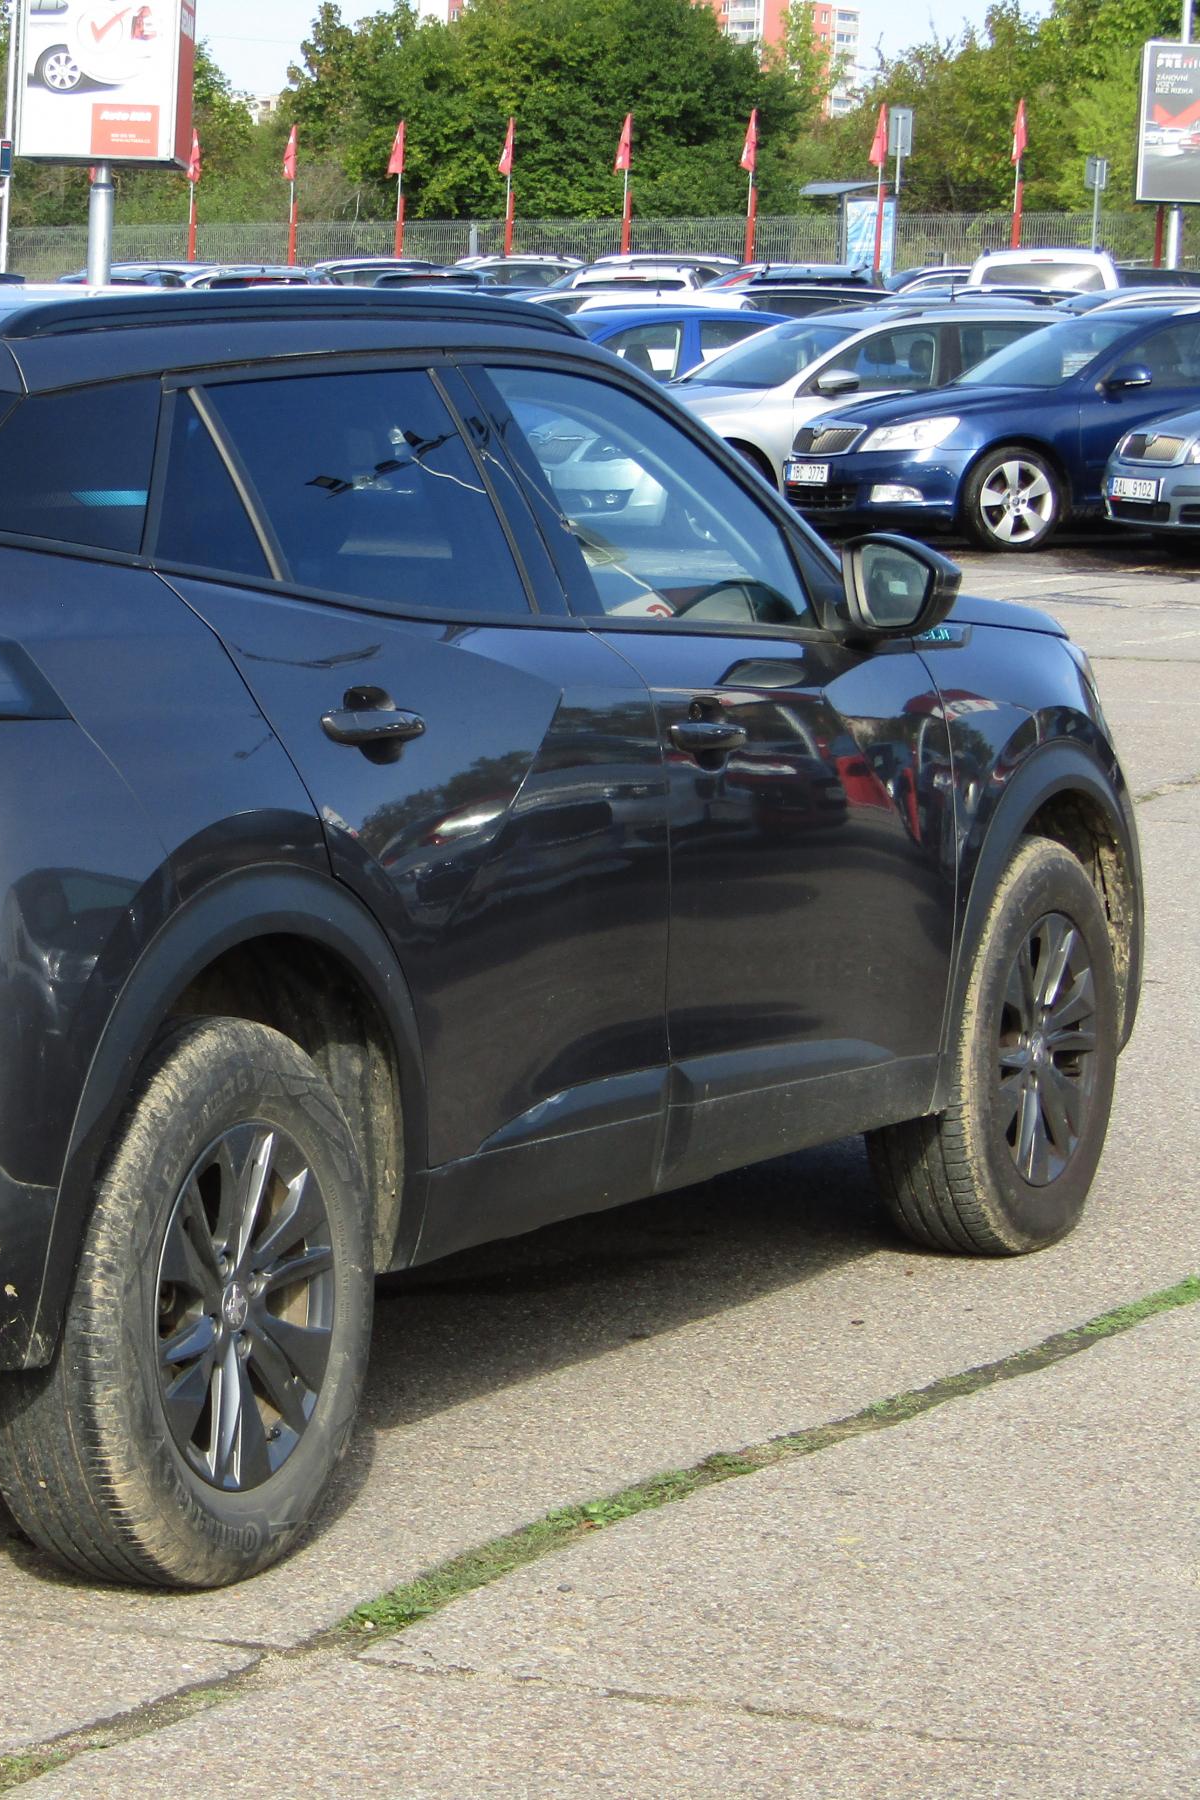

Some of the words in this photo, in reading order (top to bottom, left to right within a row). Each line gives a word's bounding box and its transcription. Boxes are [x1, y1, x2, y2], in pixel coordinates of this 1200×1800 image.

[1156, 58, 1200, 69] PREMI
[1113, 479, 1127, 495] 2AL
[1132, 481, 1153, 497] 9102
